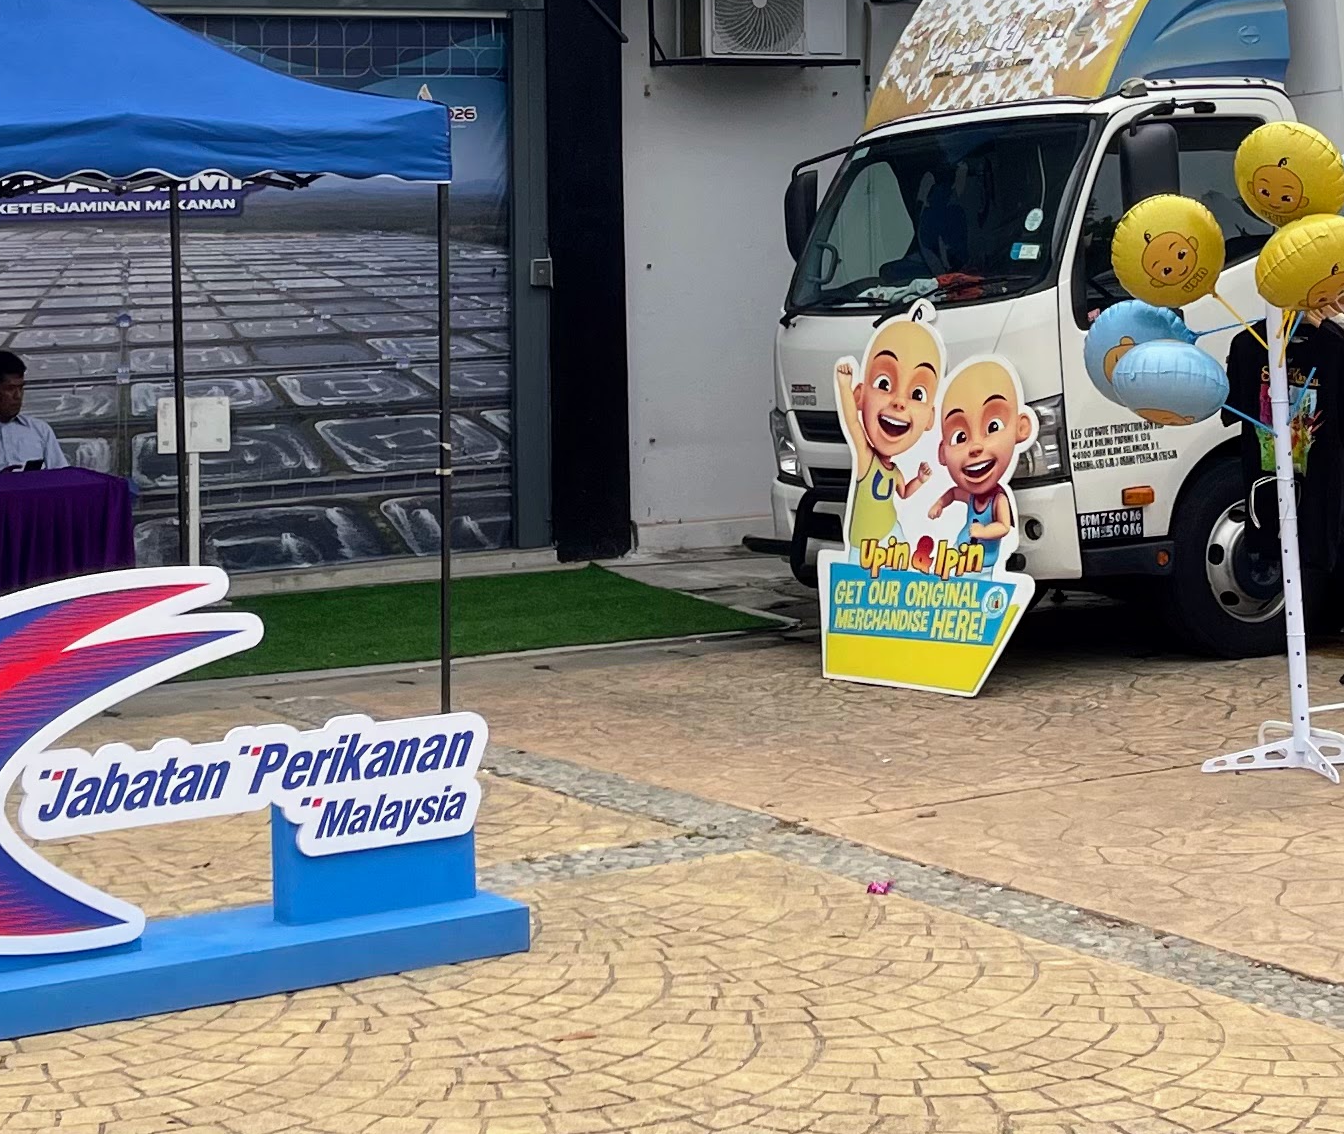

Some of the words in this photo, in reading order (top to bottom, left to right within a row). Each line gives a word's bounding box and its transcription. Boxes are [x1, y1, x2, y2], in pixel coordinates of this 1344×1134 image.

[449, 107, 477, 121] 26
[860, 536, 910, 580] Upin
[912, 535, 936, 576] &
[934, 540, 985, 581] Ipin
[834, 580, 868, 605] GET
[868, 580, 901, 608] OUR
[904, 581, 980, 609] ORIGINAL
[834, 607, 930, 633] MERCHANDISE
[930, 609, 989, 643] HERE!
[38, 756, 232, 822] Jabatan
[248, 730, 475, 796] Perikanan
[314, 784, 468, 840] Malaysia
